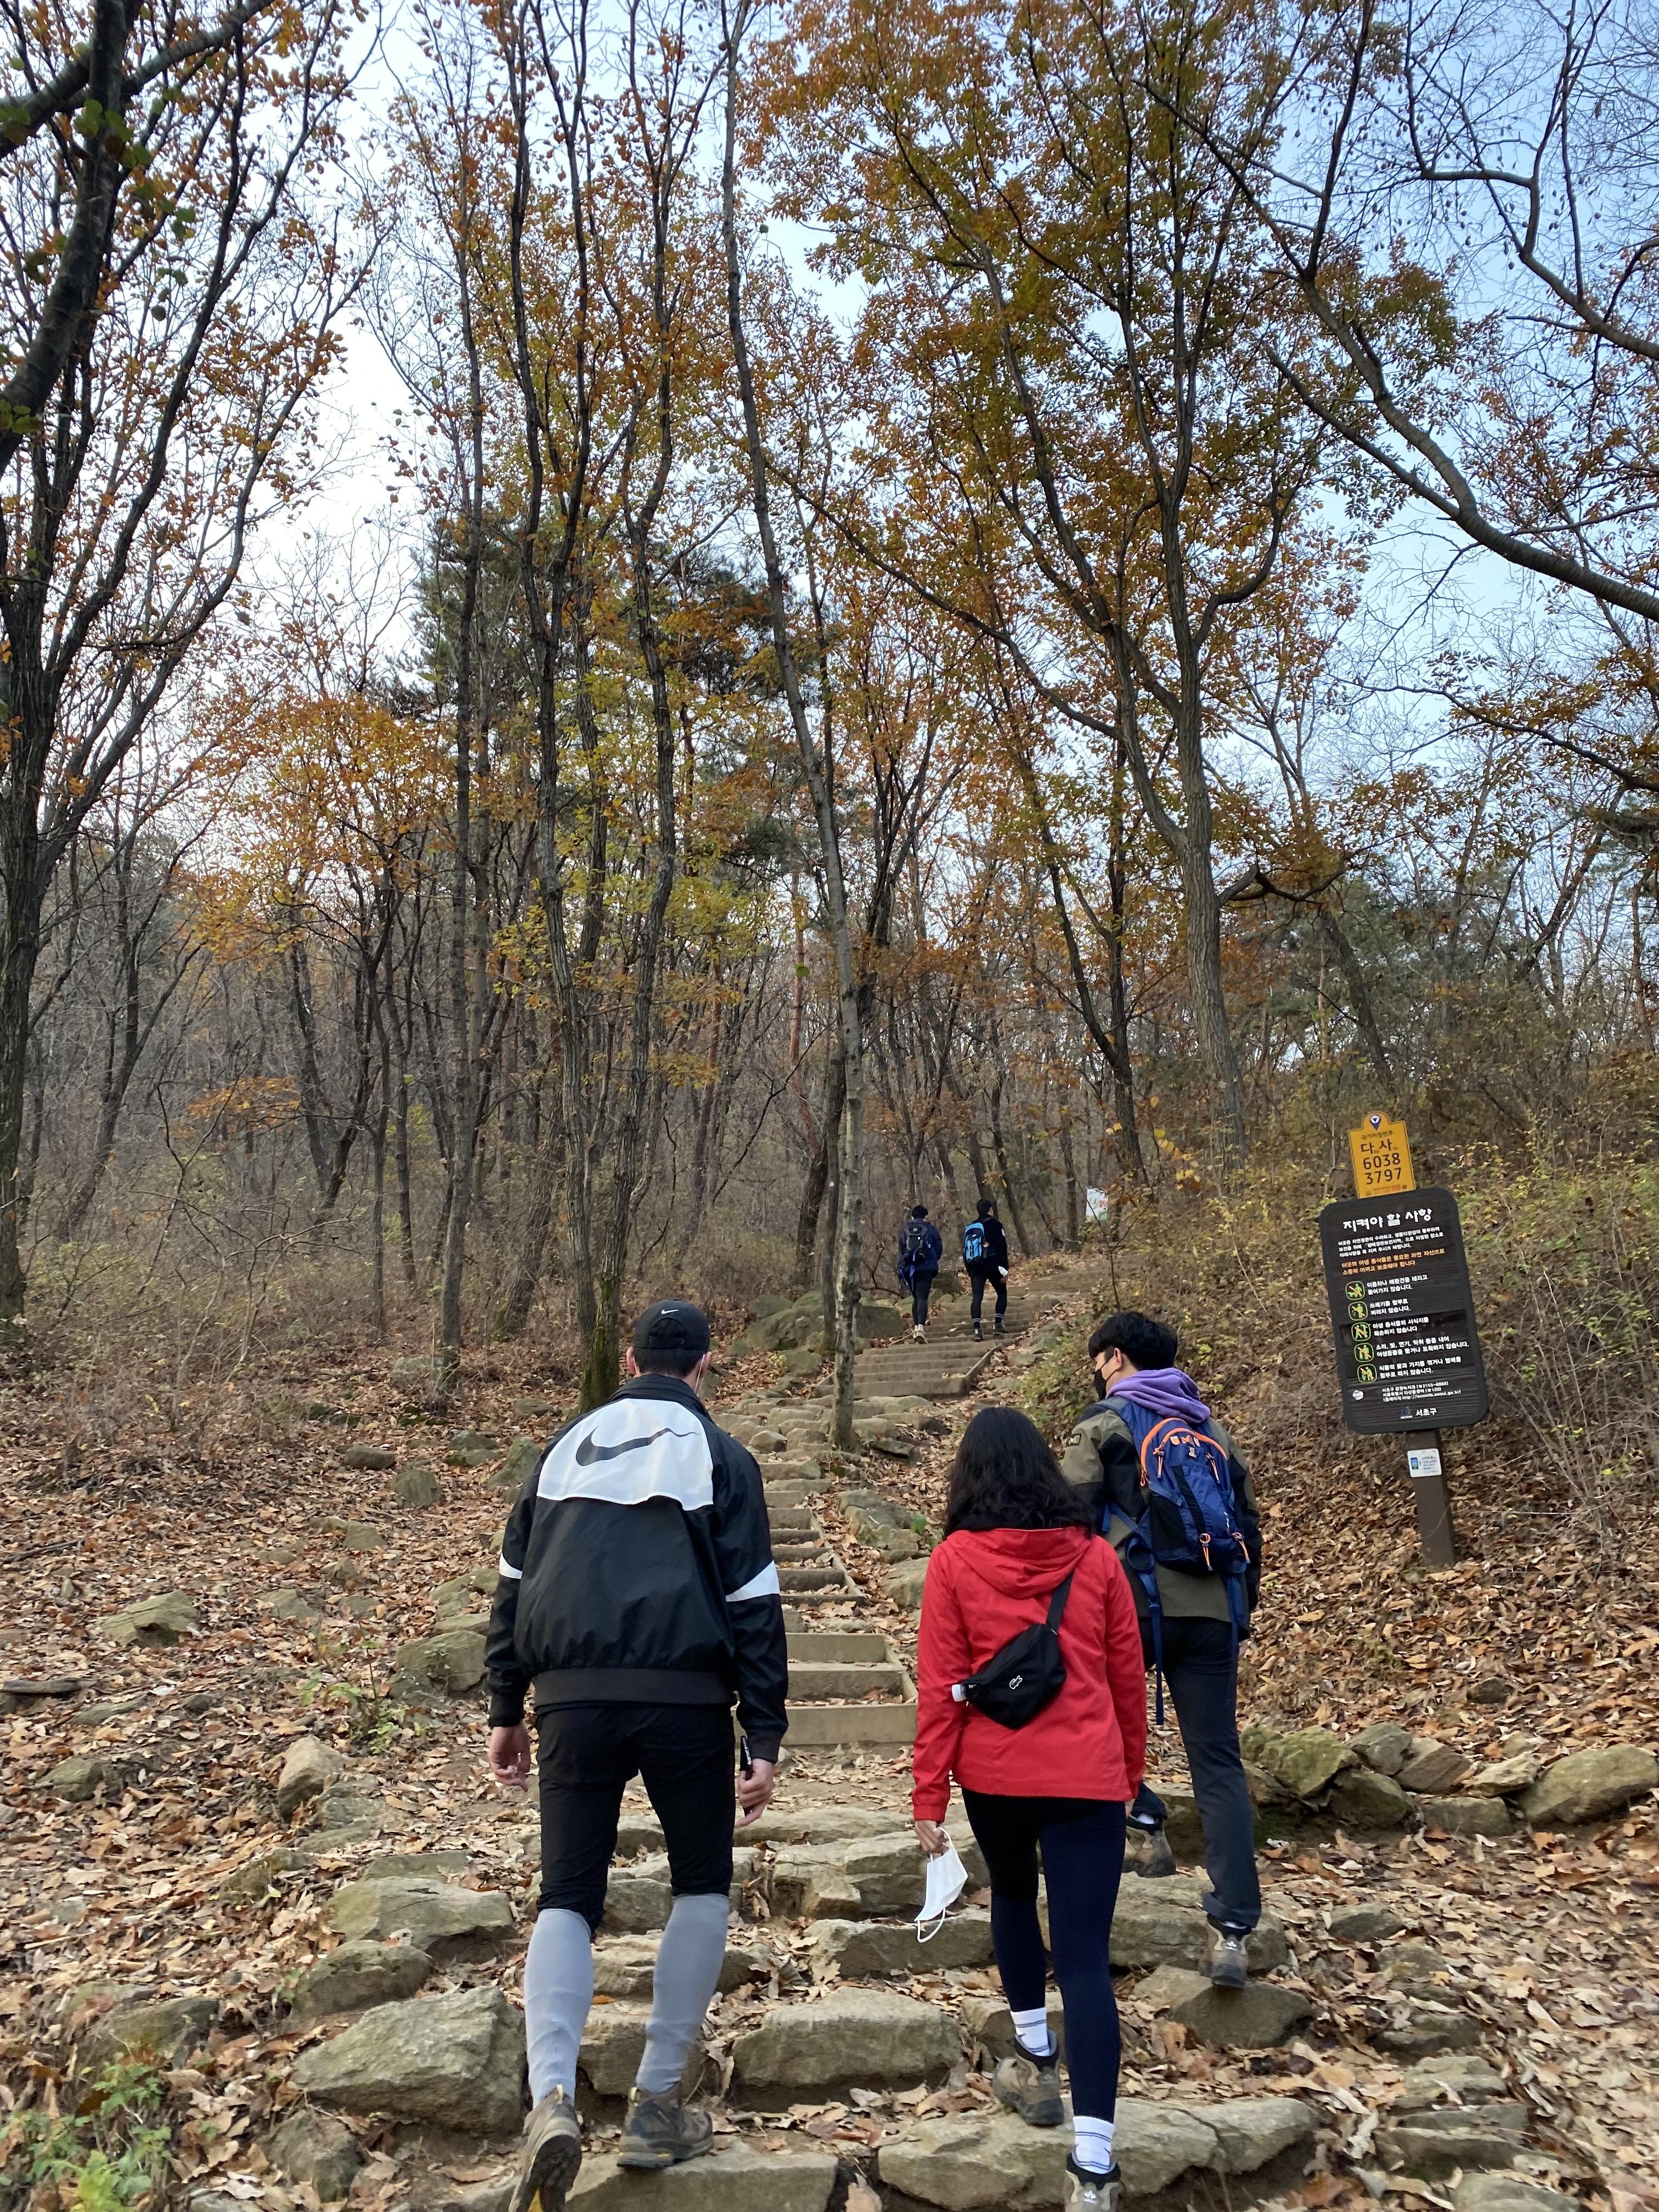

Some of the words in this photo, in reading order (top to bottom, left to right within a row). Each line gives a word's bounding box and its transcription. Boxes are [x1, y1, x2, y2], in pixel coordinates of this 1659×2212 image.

[1363, 1153, 1401, 1170] 6038
[1364, 1167, 1402, 1185] 3797
[1343, 1216, 1384, 1232] 지켜야
[1387, 1214, 1401, 1227] 할
[1406, 1209, 1432, 1223] 사항
[1416, 1408, 1437, 1417] 서초구
